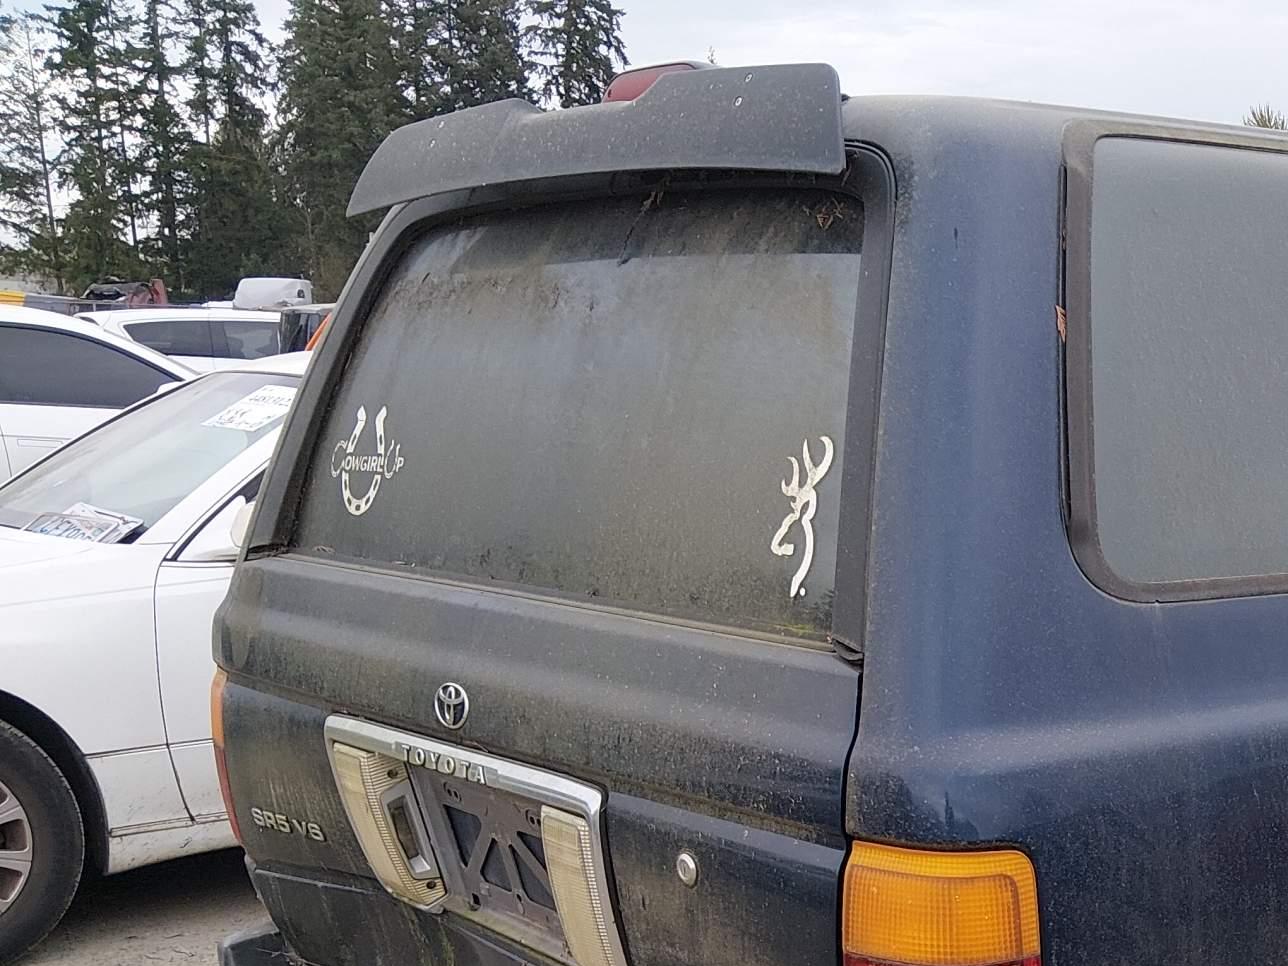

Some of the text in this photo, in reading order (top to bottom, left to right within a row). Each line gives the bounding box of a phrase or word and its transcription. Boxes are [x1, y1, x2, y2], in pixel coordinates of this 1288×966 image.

[331, 440, 405, 479] COWGIRL UP
[401, 744, 487, 785] TOYOTA
[251, 807, 326, 841] SR5 V6
